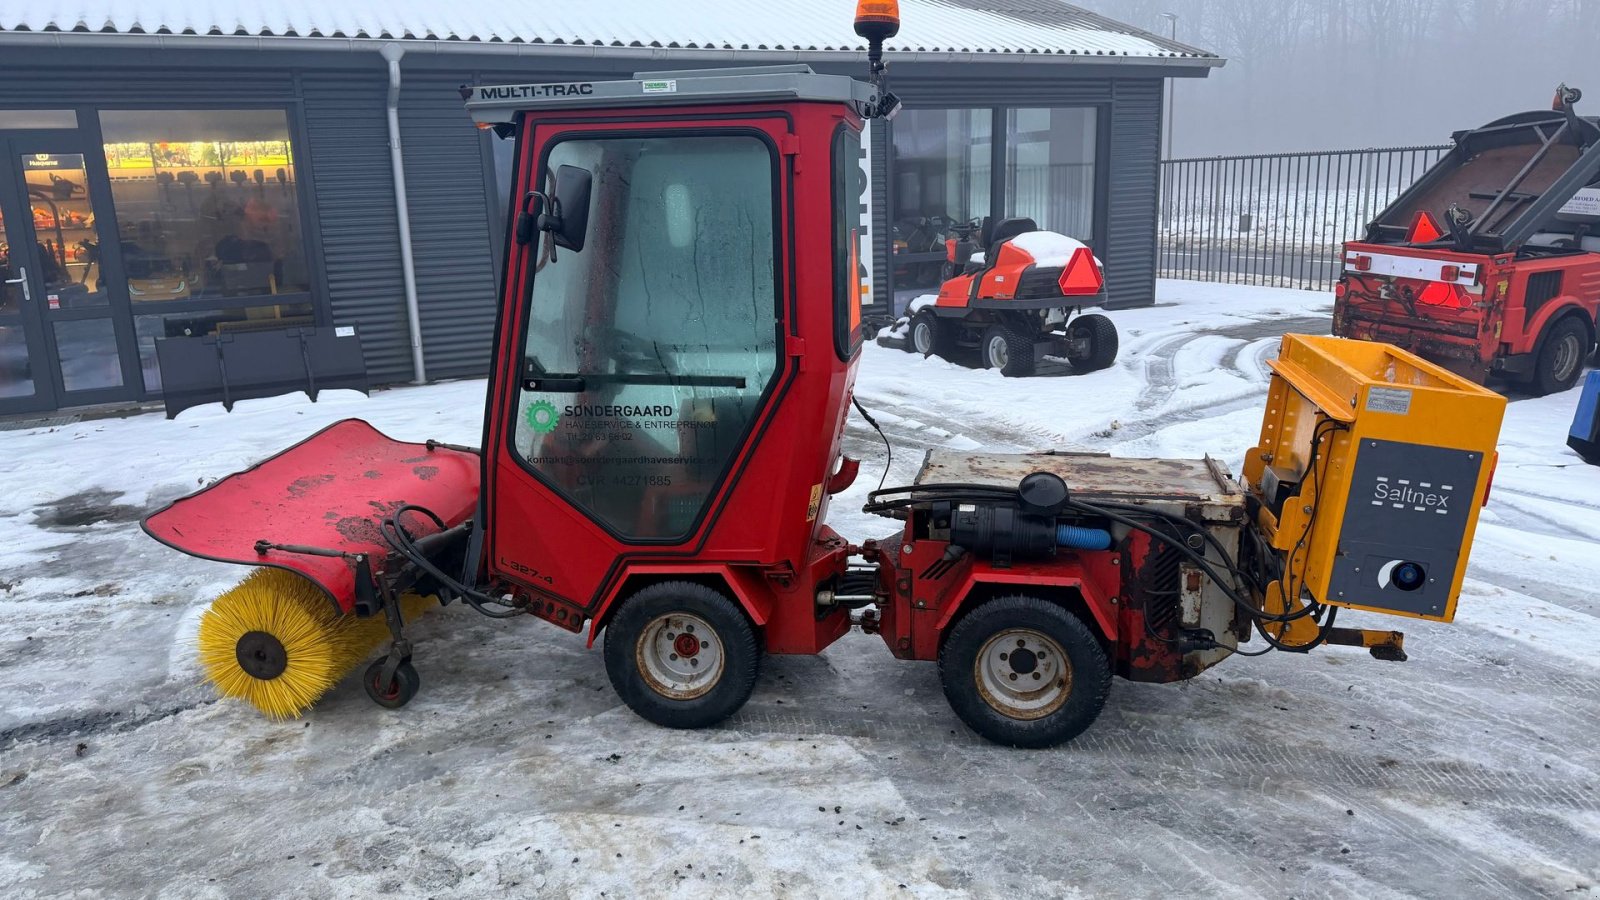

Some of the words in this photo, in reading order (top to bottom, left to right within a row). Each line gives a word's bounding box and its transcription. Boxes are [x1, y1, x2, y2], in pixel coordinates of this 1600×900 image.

[480, 83, 593, 99] MULTI-TRAC
[564, 405, 673, 417] SØNDERGAARD
[566, 420, 633, 429] HAVESERVICE
[635, 420, 642, 429] &
[621, 432, 633, 441] 02
[1374, 483, 1449, 507] Saltnex
